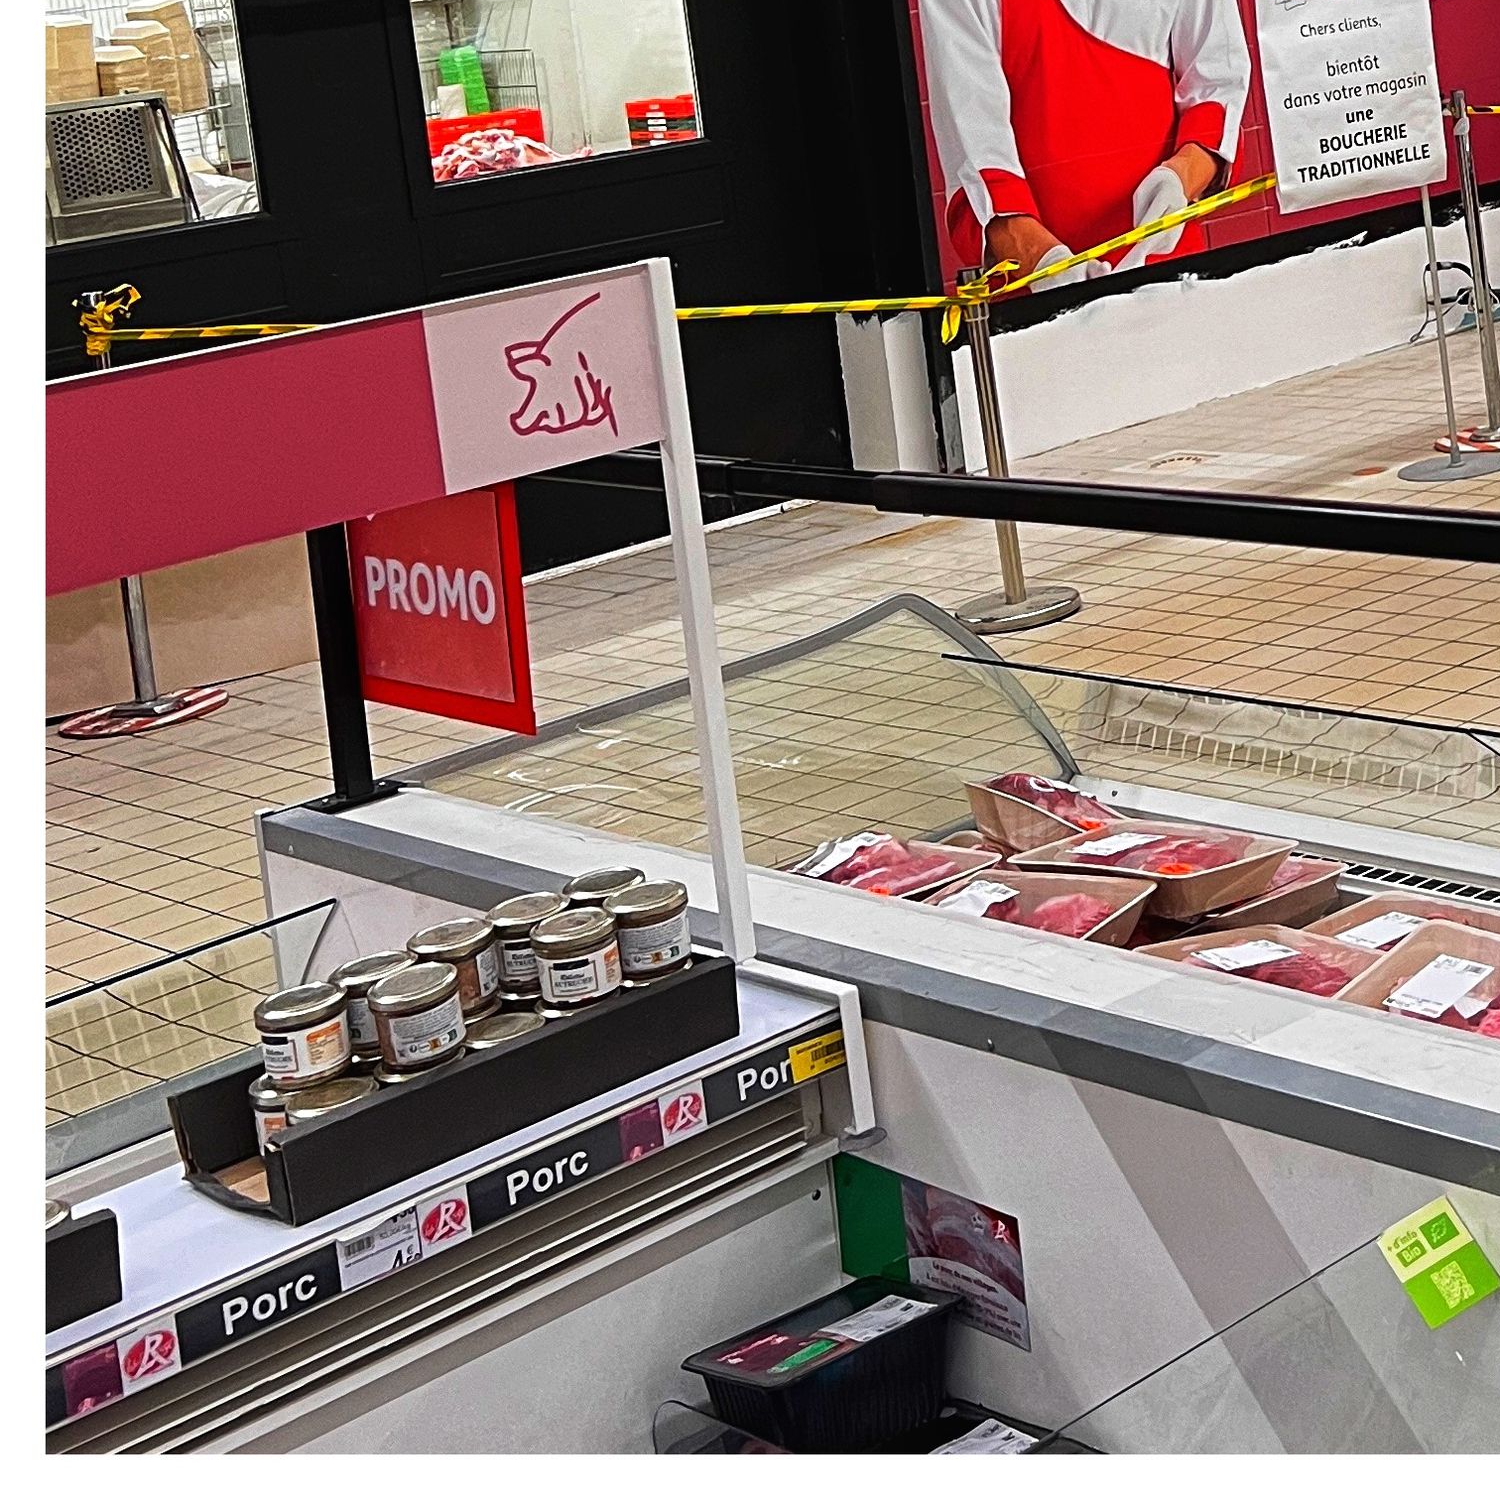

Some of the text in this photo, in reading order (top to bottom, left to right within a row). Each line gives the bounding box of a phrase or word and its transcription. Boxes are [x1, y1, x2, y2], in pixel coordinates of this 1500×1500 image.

[1300, 16, 1382, 38] Chers clients,
[1326, 55, 1380, 77] bientôt
[1283, 72, 1427, 109] dans votre magasin
[1346, 108, 1374, 124] une
[1319, 123, 1407, 154] BOUCHERIE
[1297, 143, 1430, 183] TRADITIONNELLE
[364, 555, 496, 625] PROMO
[737, 1058, 791, 1101] Por
[506, 1148, 590, 1206] Porc
[1401, 1245, 1422, 1263] Bio
[222, 1274, 318, 1336] Porc
